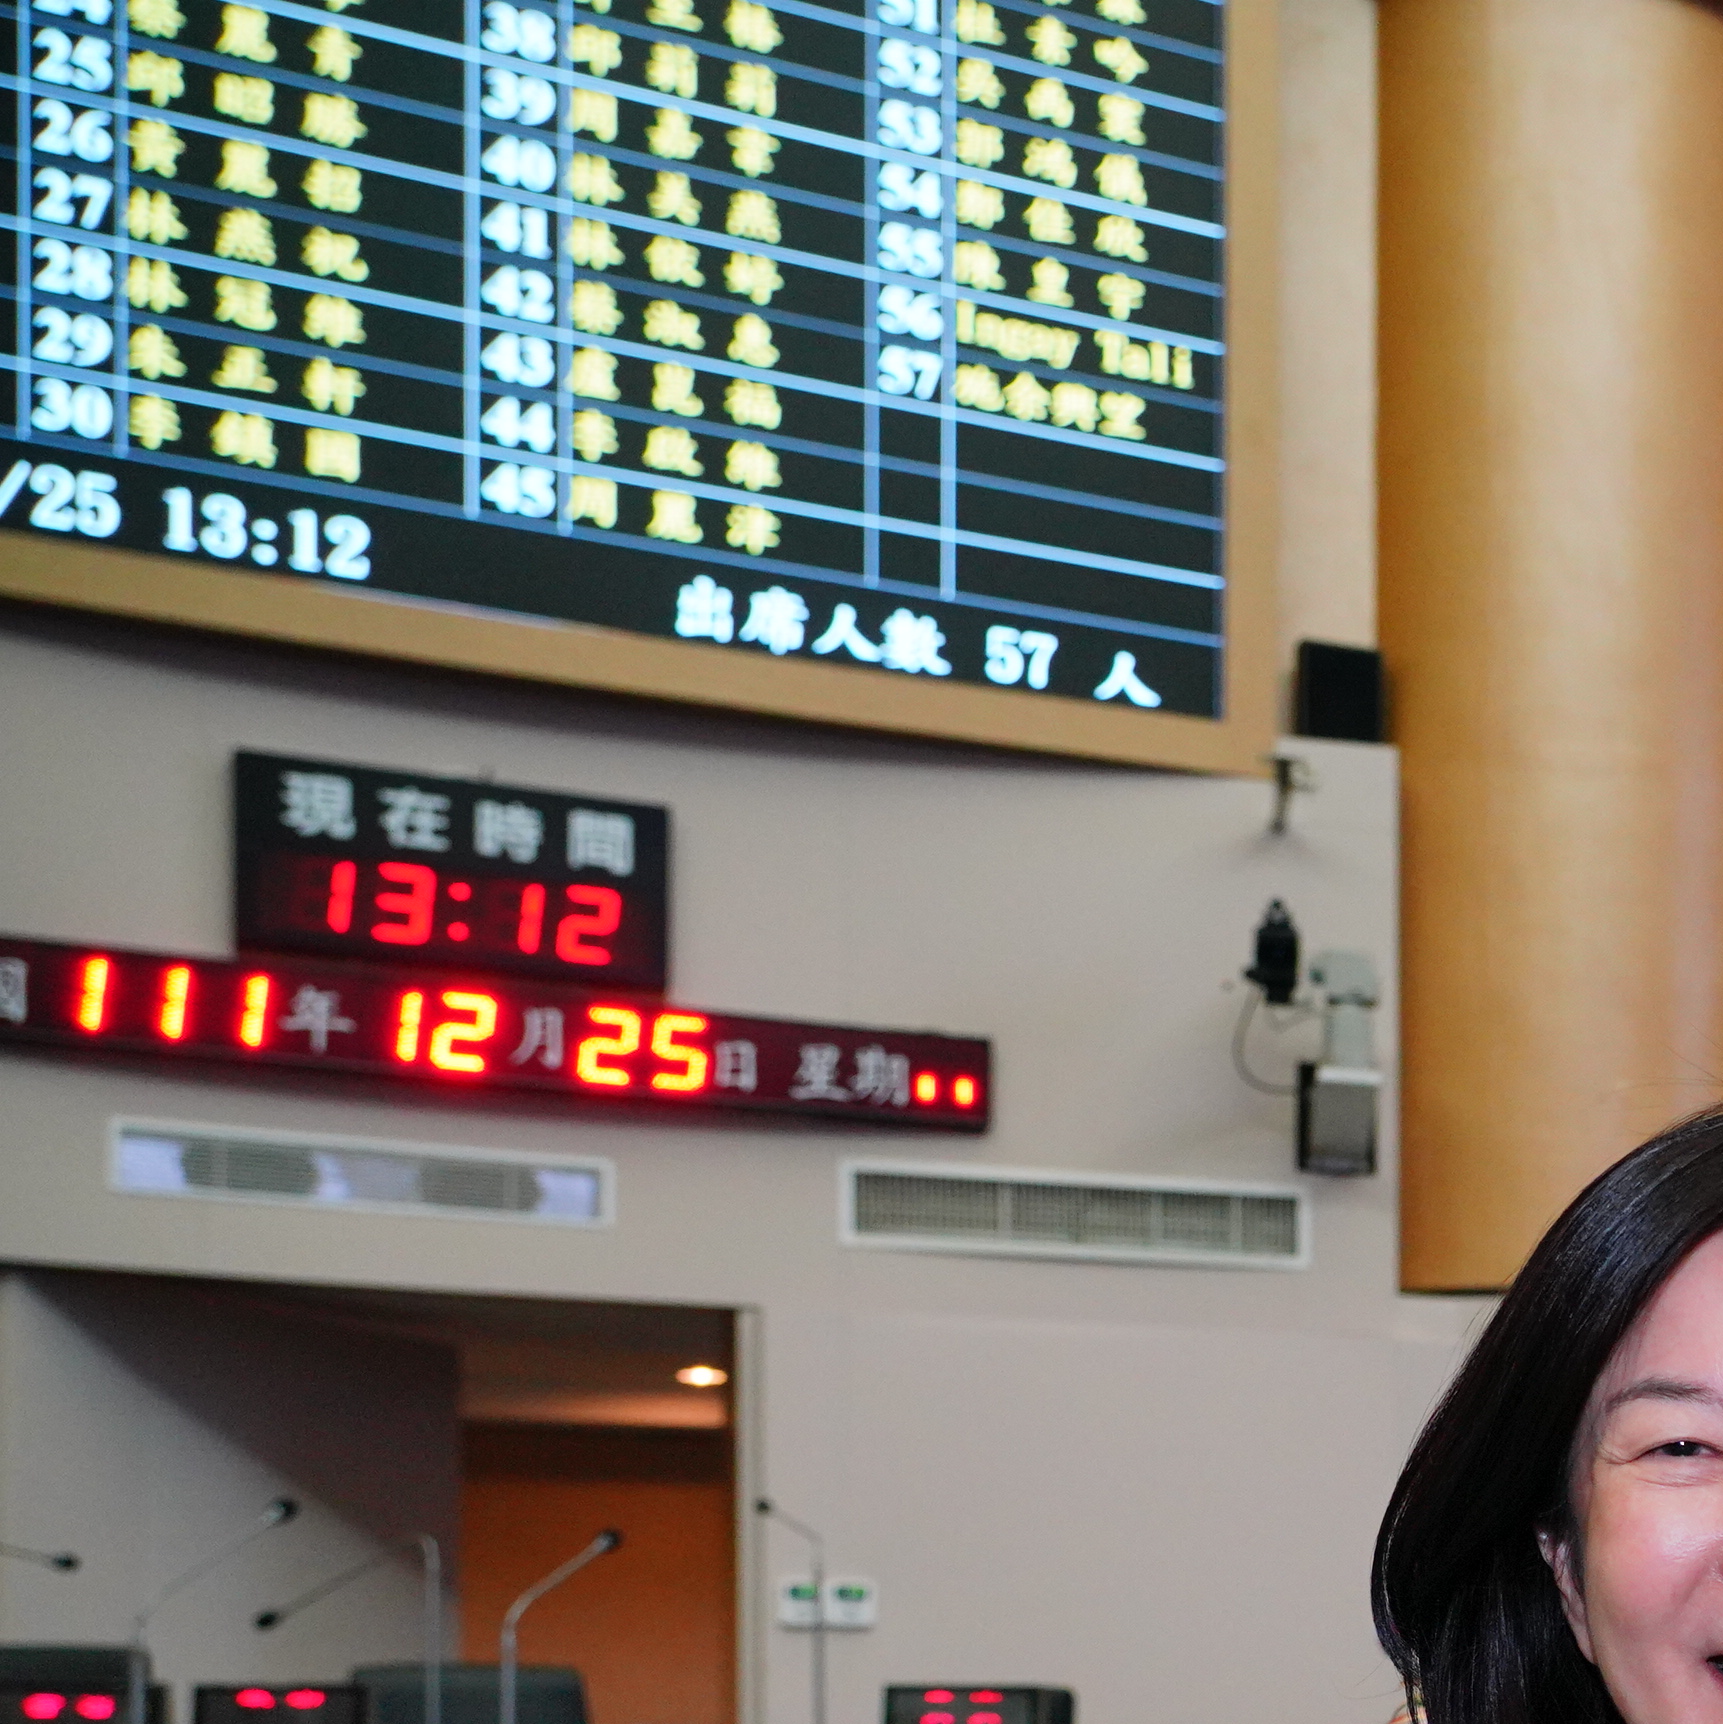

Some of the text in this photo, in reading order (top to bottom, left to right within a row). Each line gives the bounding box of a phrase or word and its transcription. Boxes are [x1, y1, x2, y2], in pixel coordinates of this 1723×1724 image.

[33, 27, 113, 92] 25
[481, 1, 556, 63] 38
[481, 67, 556, 126] 39
[876, 37, 944, 97] 52
[33, 98, 113, 163] 26
[876, 99, 943, 156] 53
[481, 134, 556, 192] 40
[876, 161, 944, 219] 54
[33, 167, 113, 230] 27
[481, 200, 552, 260] 41
[876, 221, 944, 279] 55
[33, 238, 113, 300] 28
[481, 264, 555, 324] 42
[32, 306, 113, 367] 29
[876, 283, 944, 341] 56
[481, 332, 555, 388] 43
[876, 344, 944, 401] 57
[31, 377, 113, 438] 30
[480, 395, 556, 453] 44
[480, 462, 556, 518] 45
[161, 486, 372, 581] 13:12
[674, 574, 1163, 708] 出席人數 57 人
[280, 770, 637, 877] 現在時間
[326, 860, 623, 967] 13:12
